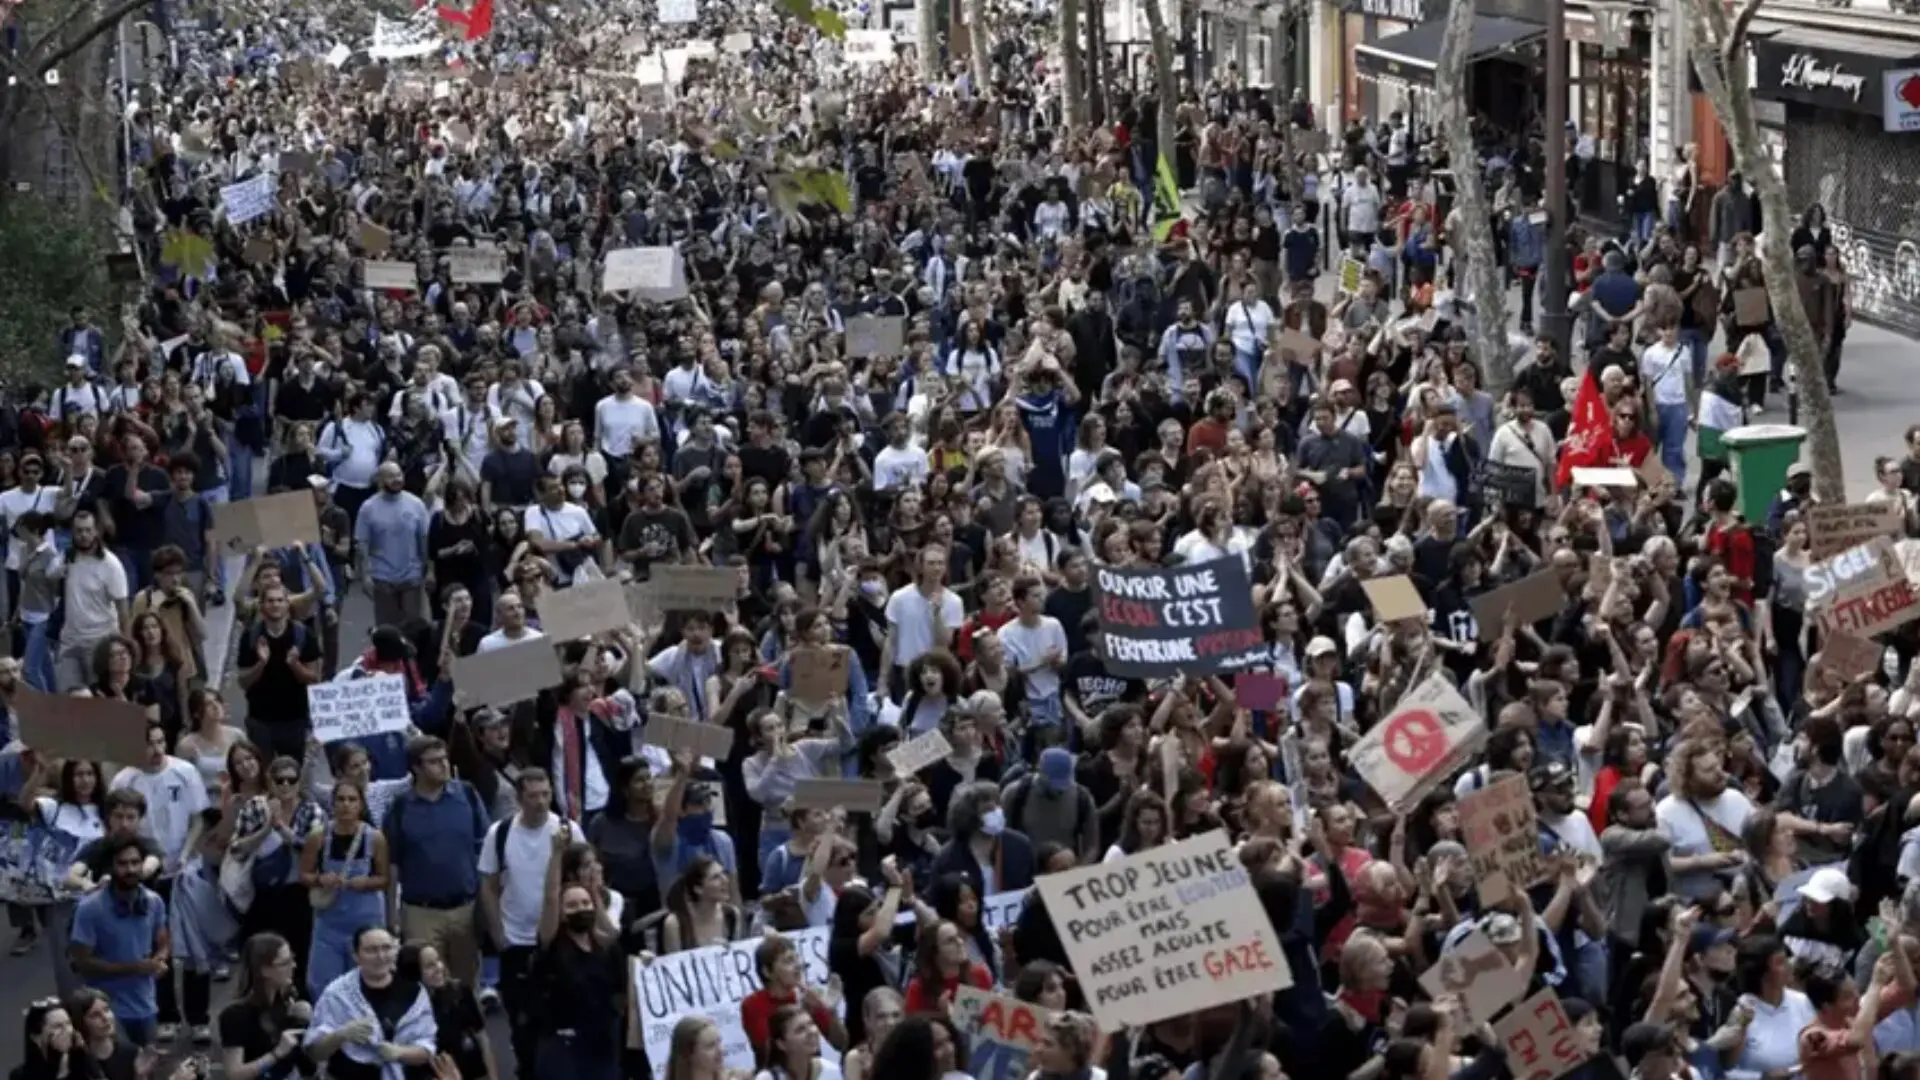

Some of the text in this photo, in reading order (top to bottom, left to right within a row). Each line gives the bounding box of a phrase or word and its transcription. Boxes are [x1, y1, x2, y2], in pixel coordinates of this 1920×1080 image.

[1098, 569, 1218, 600] OUVRIR UNE
[1162, 596, 1224, 626] C'EST
[1064, 849, 1235, 910] TROP JEUNE
[1067, 913, 1126, 943] POUR
[1139, 910, 1191, 940] MAIS
[1090, 920, 1231, 977] ASSEZ ADULTE
[1096, 930, 1274, 1007] POUR ÊTRE GAZÉ
[640, 935, 830, 1019] UNIVERES
